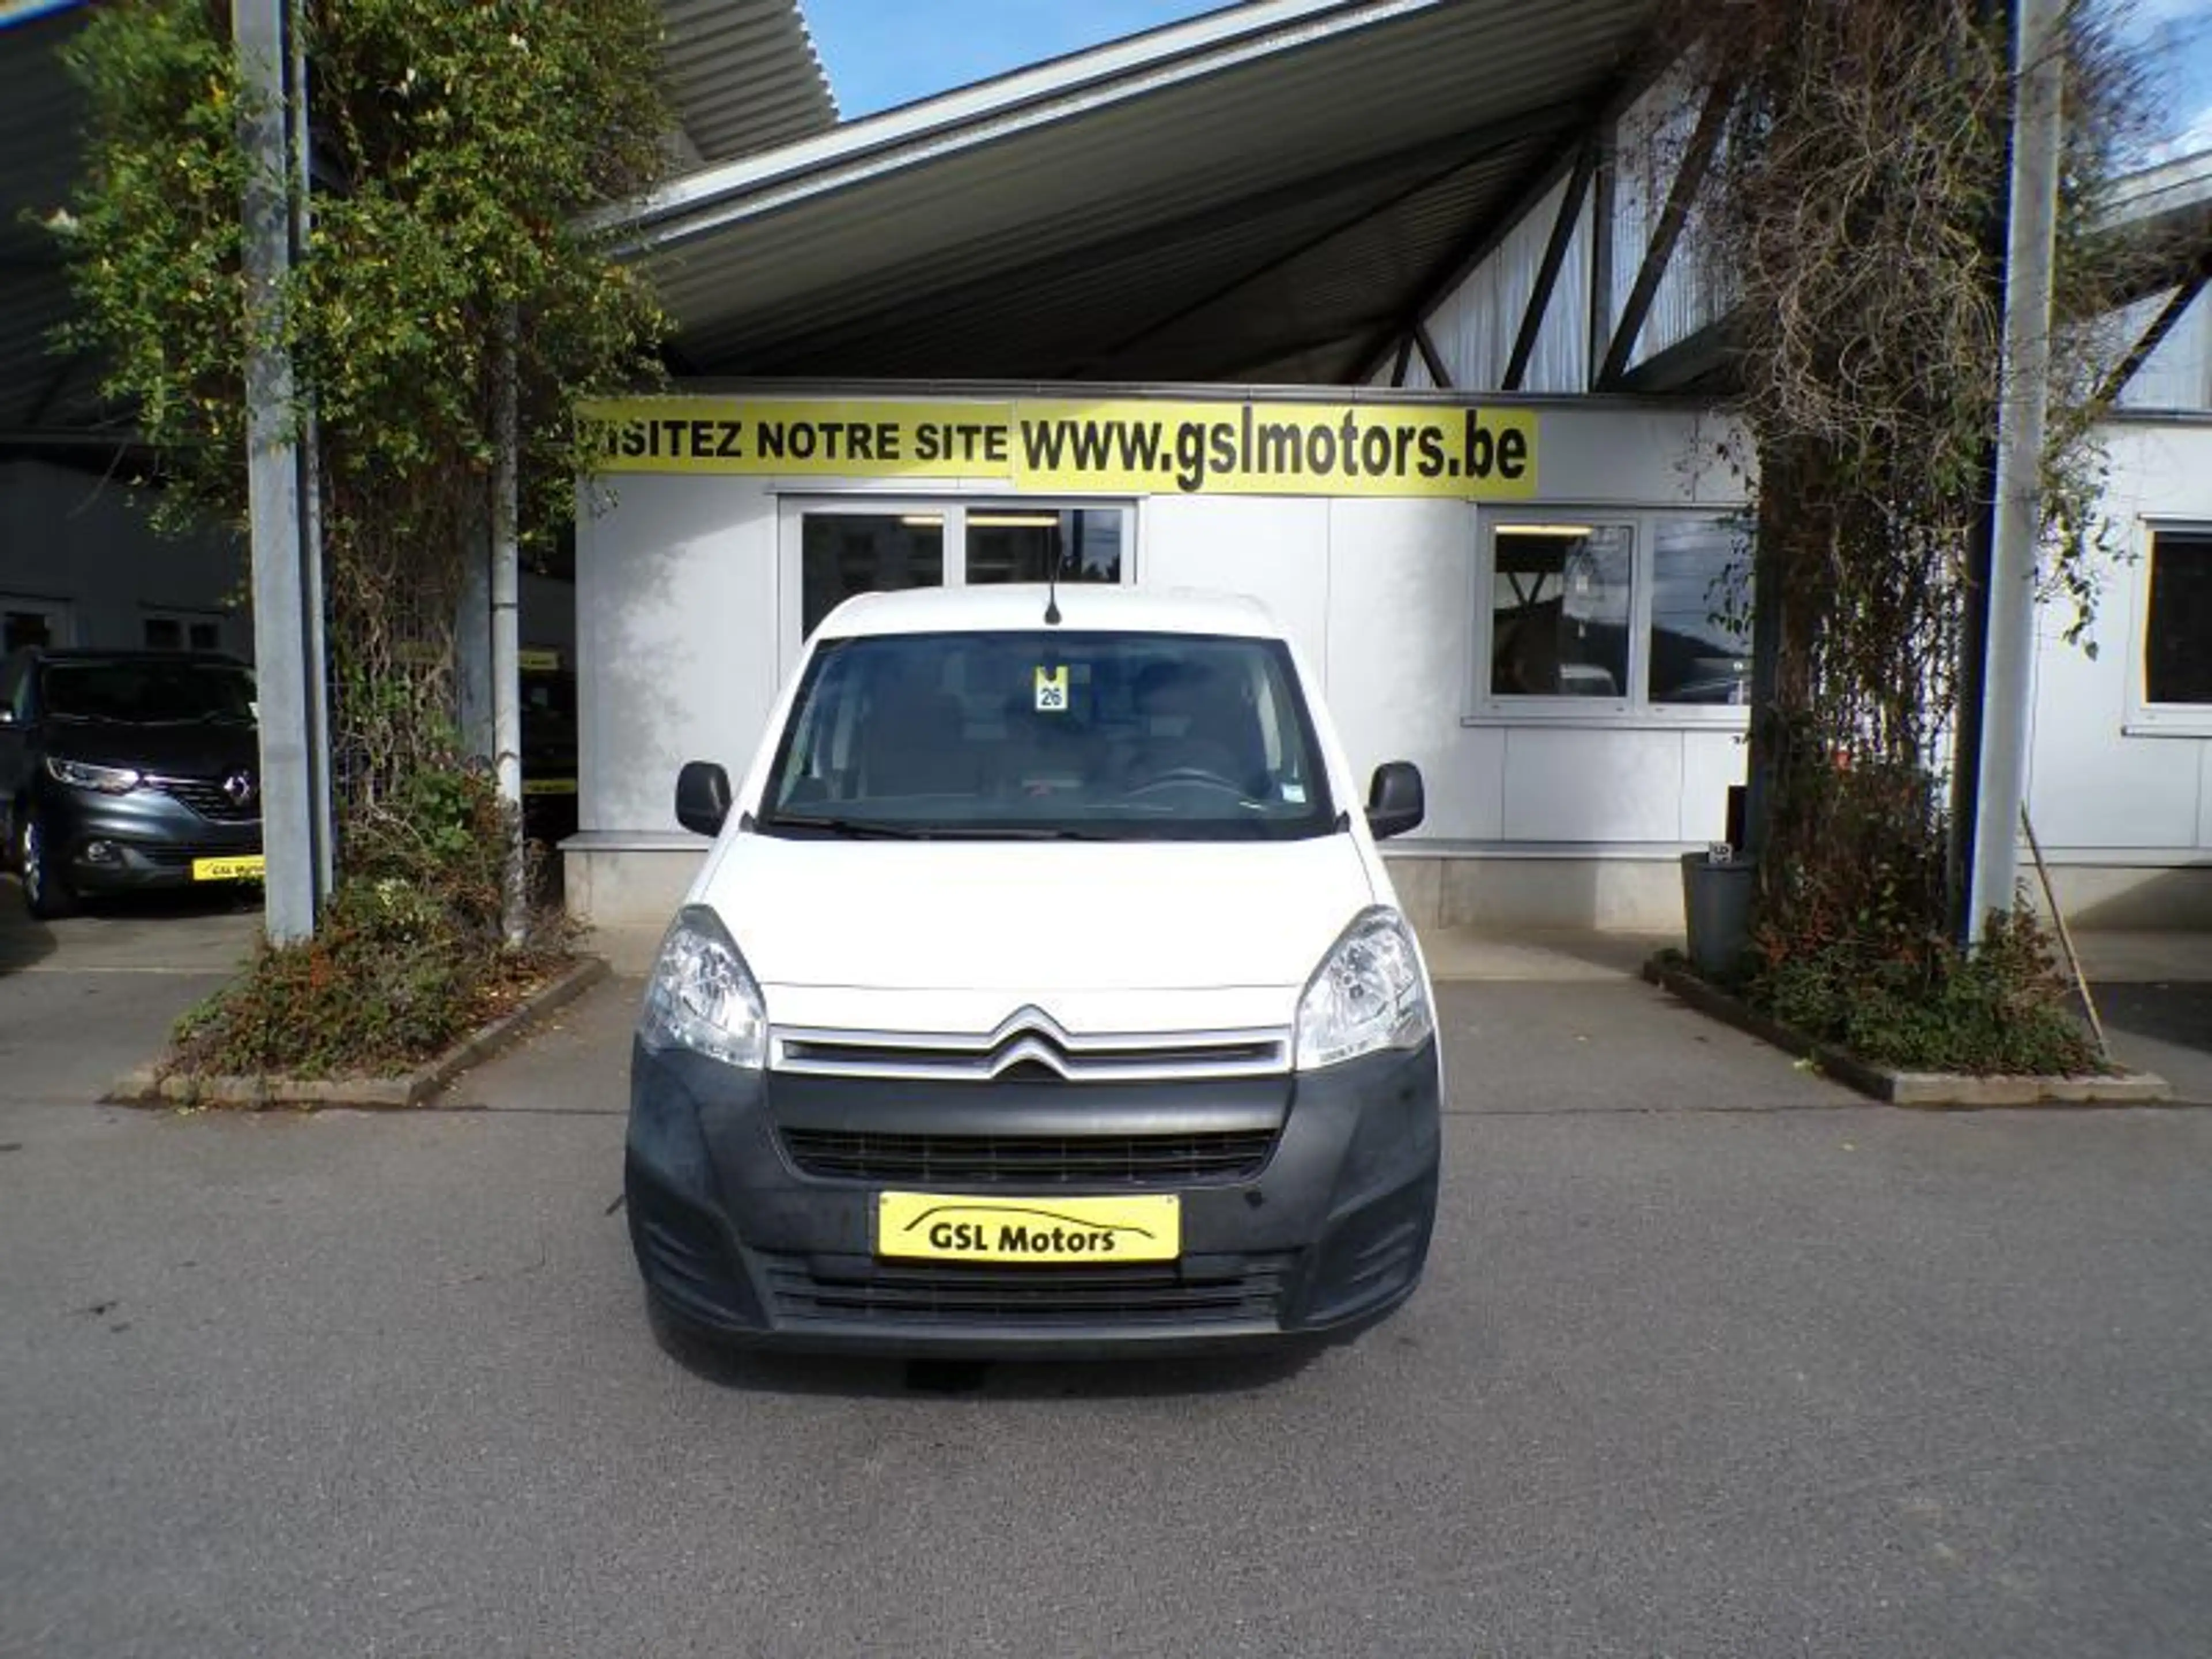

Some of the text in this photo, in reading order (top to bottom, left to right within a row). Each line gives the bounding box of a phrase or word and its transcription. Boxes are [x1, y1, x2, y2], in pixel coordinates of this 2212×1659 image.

[757, 421, 899, 460] NOTRE
[915, 423, 1008, 461] SITE
[1021, 405, 1528, 491] www.gslmotors.be
[1040, 688, 1063, 706] 26
[929, 1222, 1116, 1253] GSL Motors
